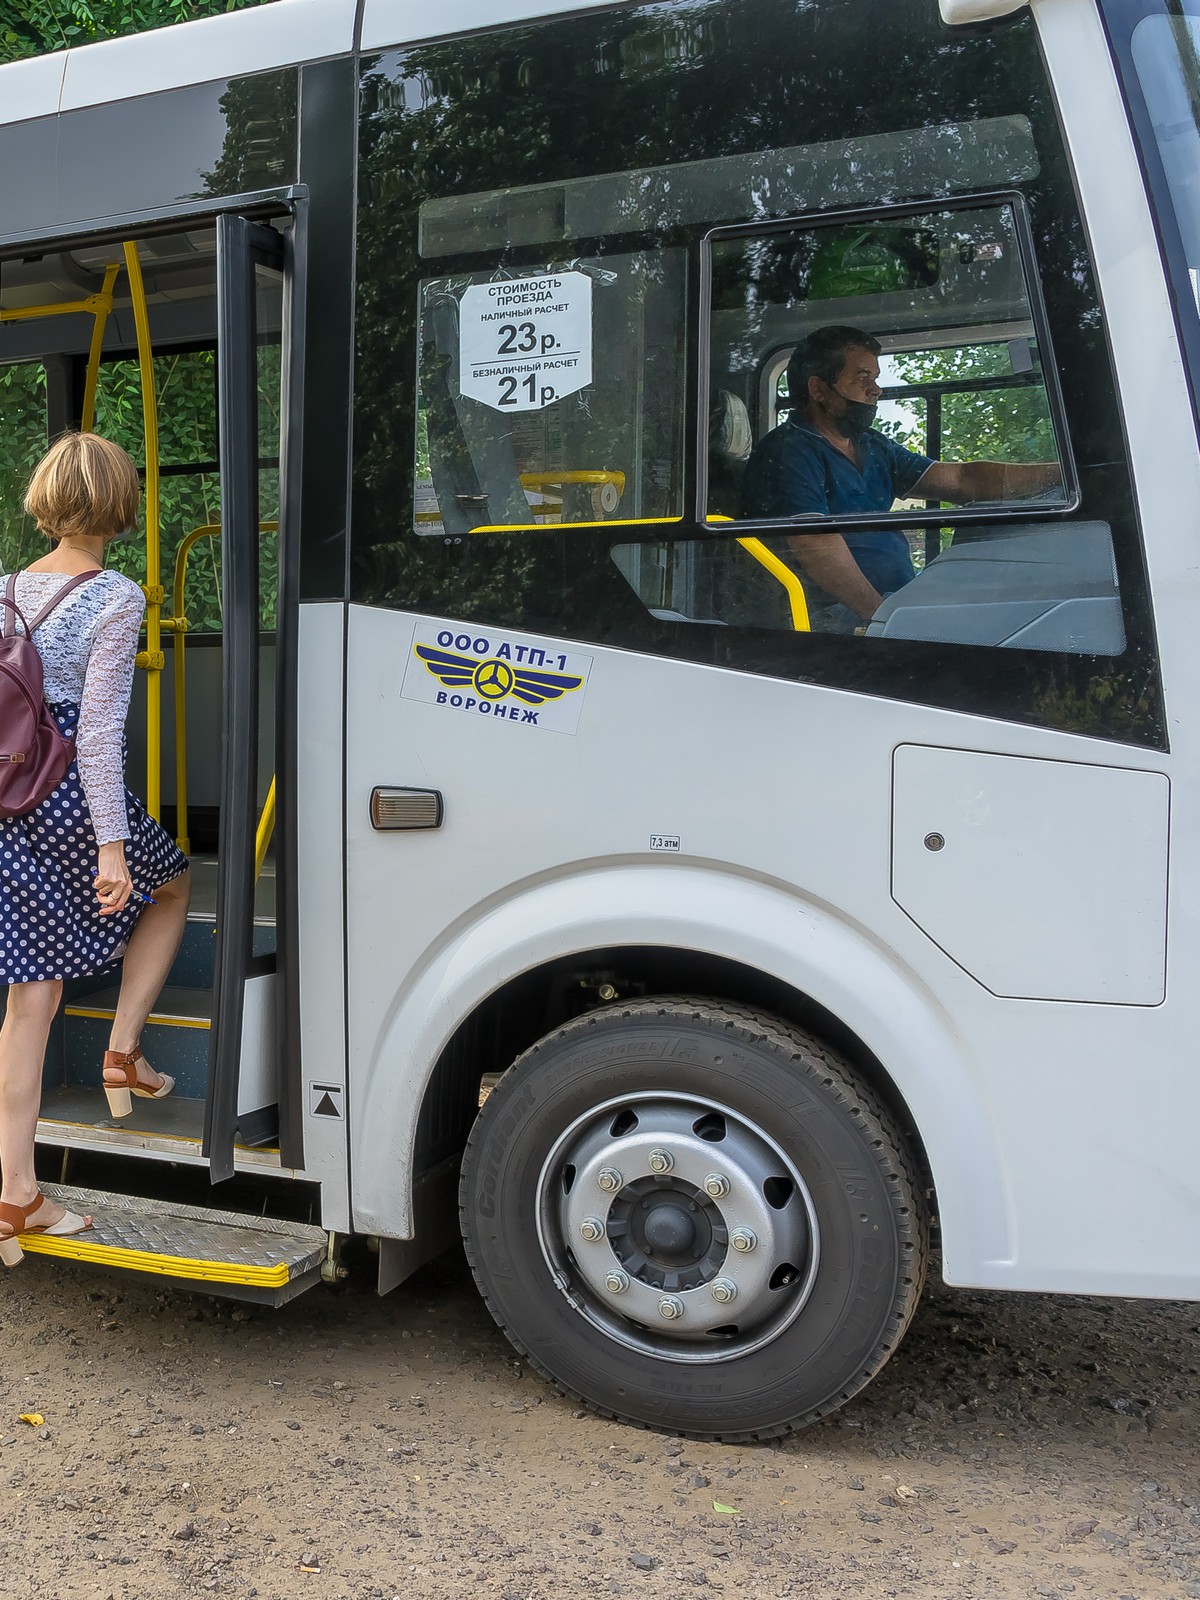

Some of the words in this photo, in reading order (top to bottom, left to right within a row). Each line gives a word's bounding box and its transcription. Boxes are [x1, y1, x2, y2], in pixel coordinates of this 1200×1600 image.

[488, 279, 562, 297] СТОИМОСТЬ
[497, 292, 553, 307] ПРОЕЗДА
[481, 307, 533, 322] НАЛИЧНЫЙ
[535, 303, 570, 316] РАСЧЕТ
[472, 361, 541, 378] БЕЗНАЛИЧНЫЙ
[543, 358, 579, 371] РАСЧЕТ
[437, 631, 490, 655] ООО
[495, 642, 567, 671] АТП-1
[436, 691, 540, 725] ВОРОНЕЖ
[652, 837, 663, 848] 7,3
